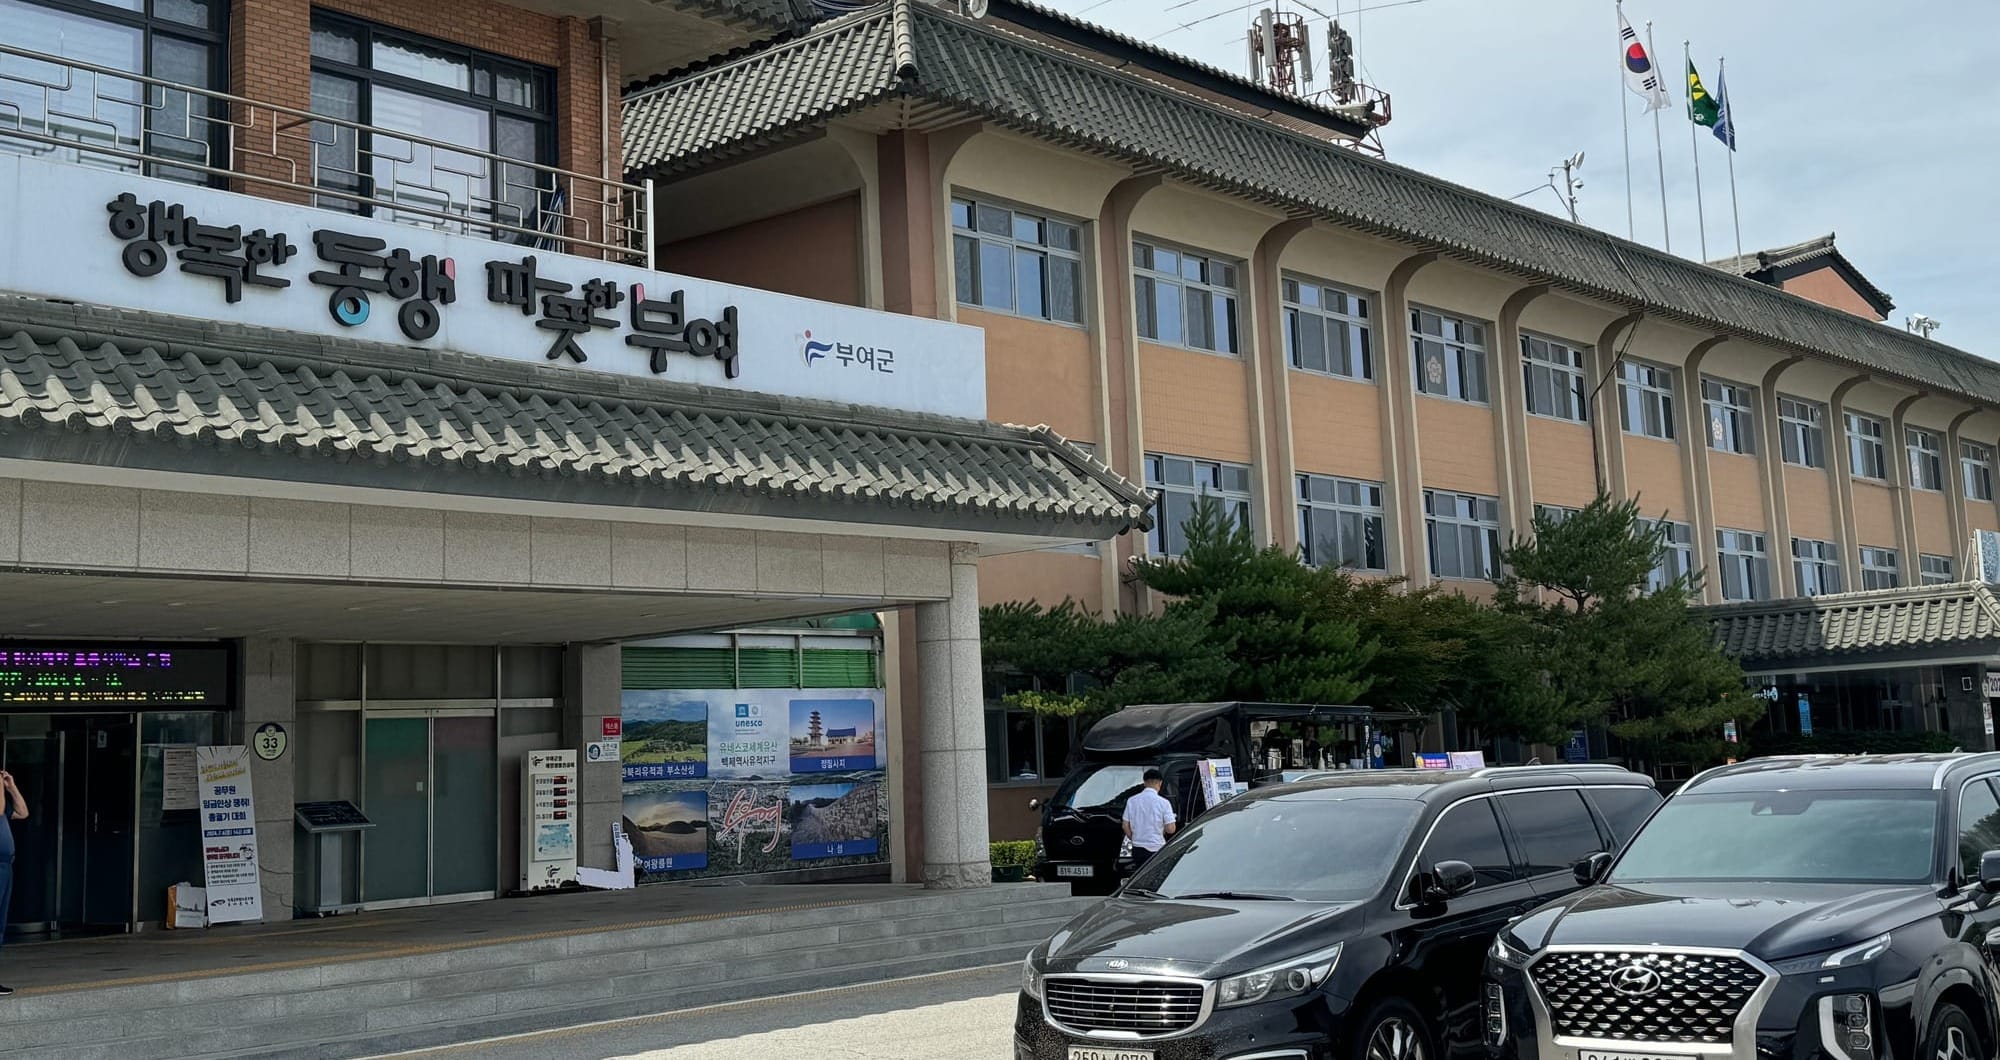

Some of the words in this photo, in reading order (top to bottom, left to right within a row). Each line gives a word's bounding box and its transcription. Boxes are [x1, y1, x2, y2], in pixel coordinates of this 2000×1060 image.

[107, 192, 297, 303] 행복한
[309, 230, 456, 341] 동행
[485, 255, 625, 363] 따뜻한
[625, 282, 739, 379] 부여
[836, 342, 894, 374] 부여군
[736, 719, 763, 727] unesco
[263, 737, 278, 749] 33
[720, 741, 778, 754] 유네스코세계유산
[721, 755, 776, 768] 백제역사유적지구
[666, 763, 695, 776] 부소산성
[213, 785, 236, 795] 공무원
[203, 799, 232, 809] 임금인상
